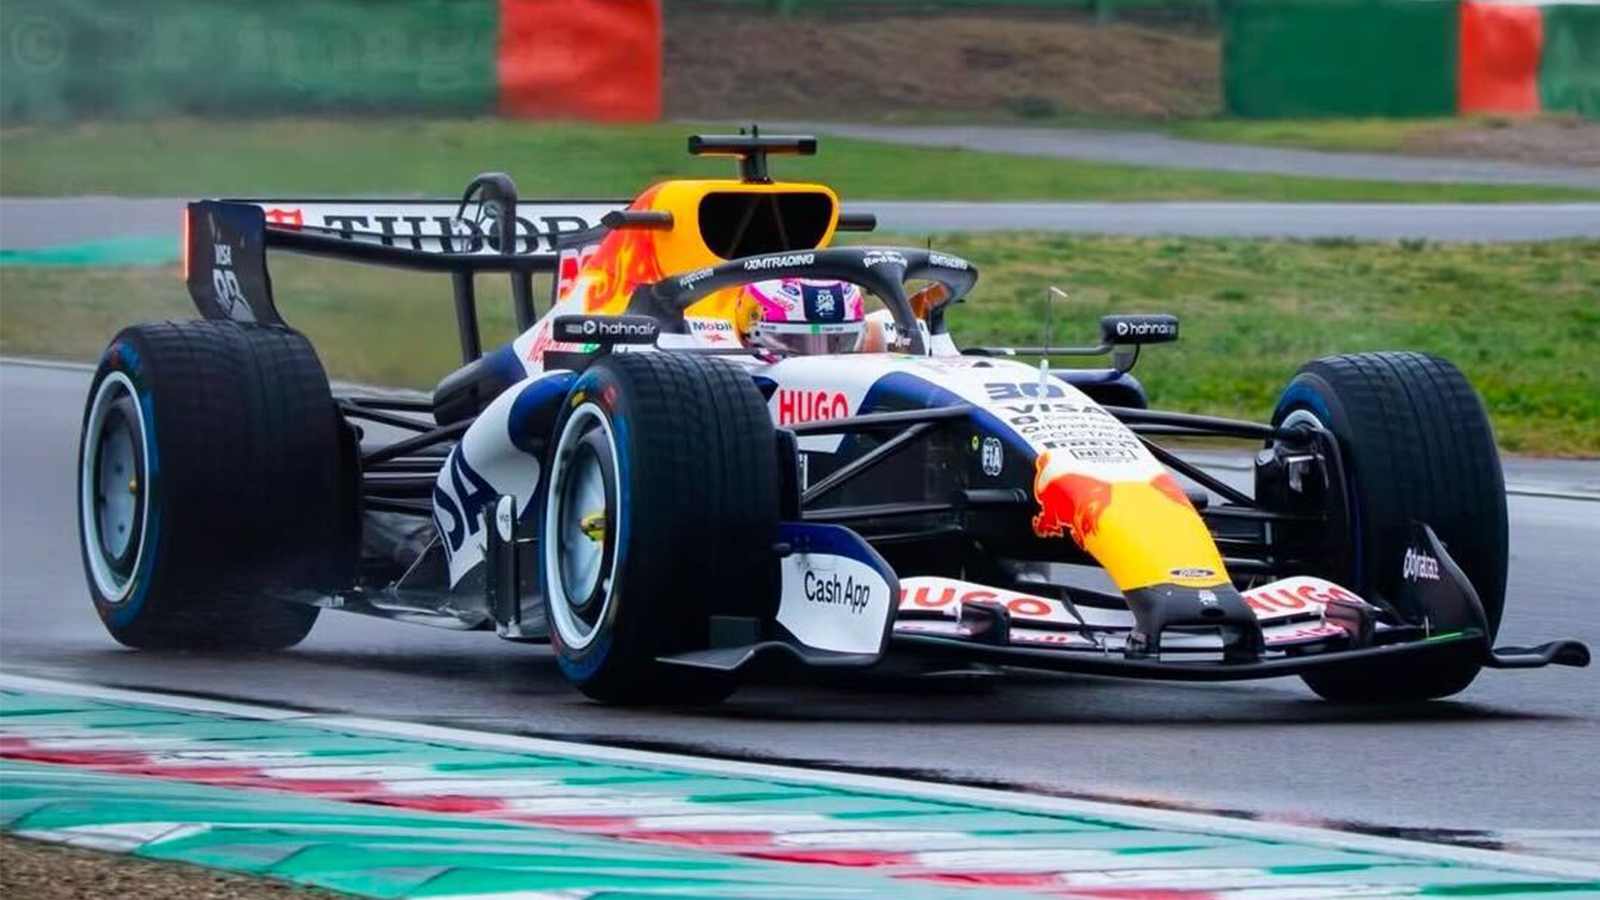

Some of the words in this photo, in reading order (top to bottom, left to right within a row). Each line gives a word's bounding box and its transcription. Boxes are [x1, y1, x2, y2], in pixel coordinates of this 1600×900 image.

[599, 322, 656, 334] hahnair
[1129, 321, 1175, 334] hahnair
[984, 383, 1066, 400] 30
[778, 389, 849, 424] HUGO
[1004, 403, 1109, 416] VISA
[804, 570, 841, 604] Cash
[843, 575, 870, 614] App
